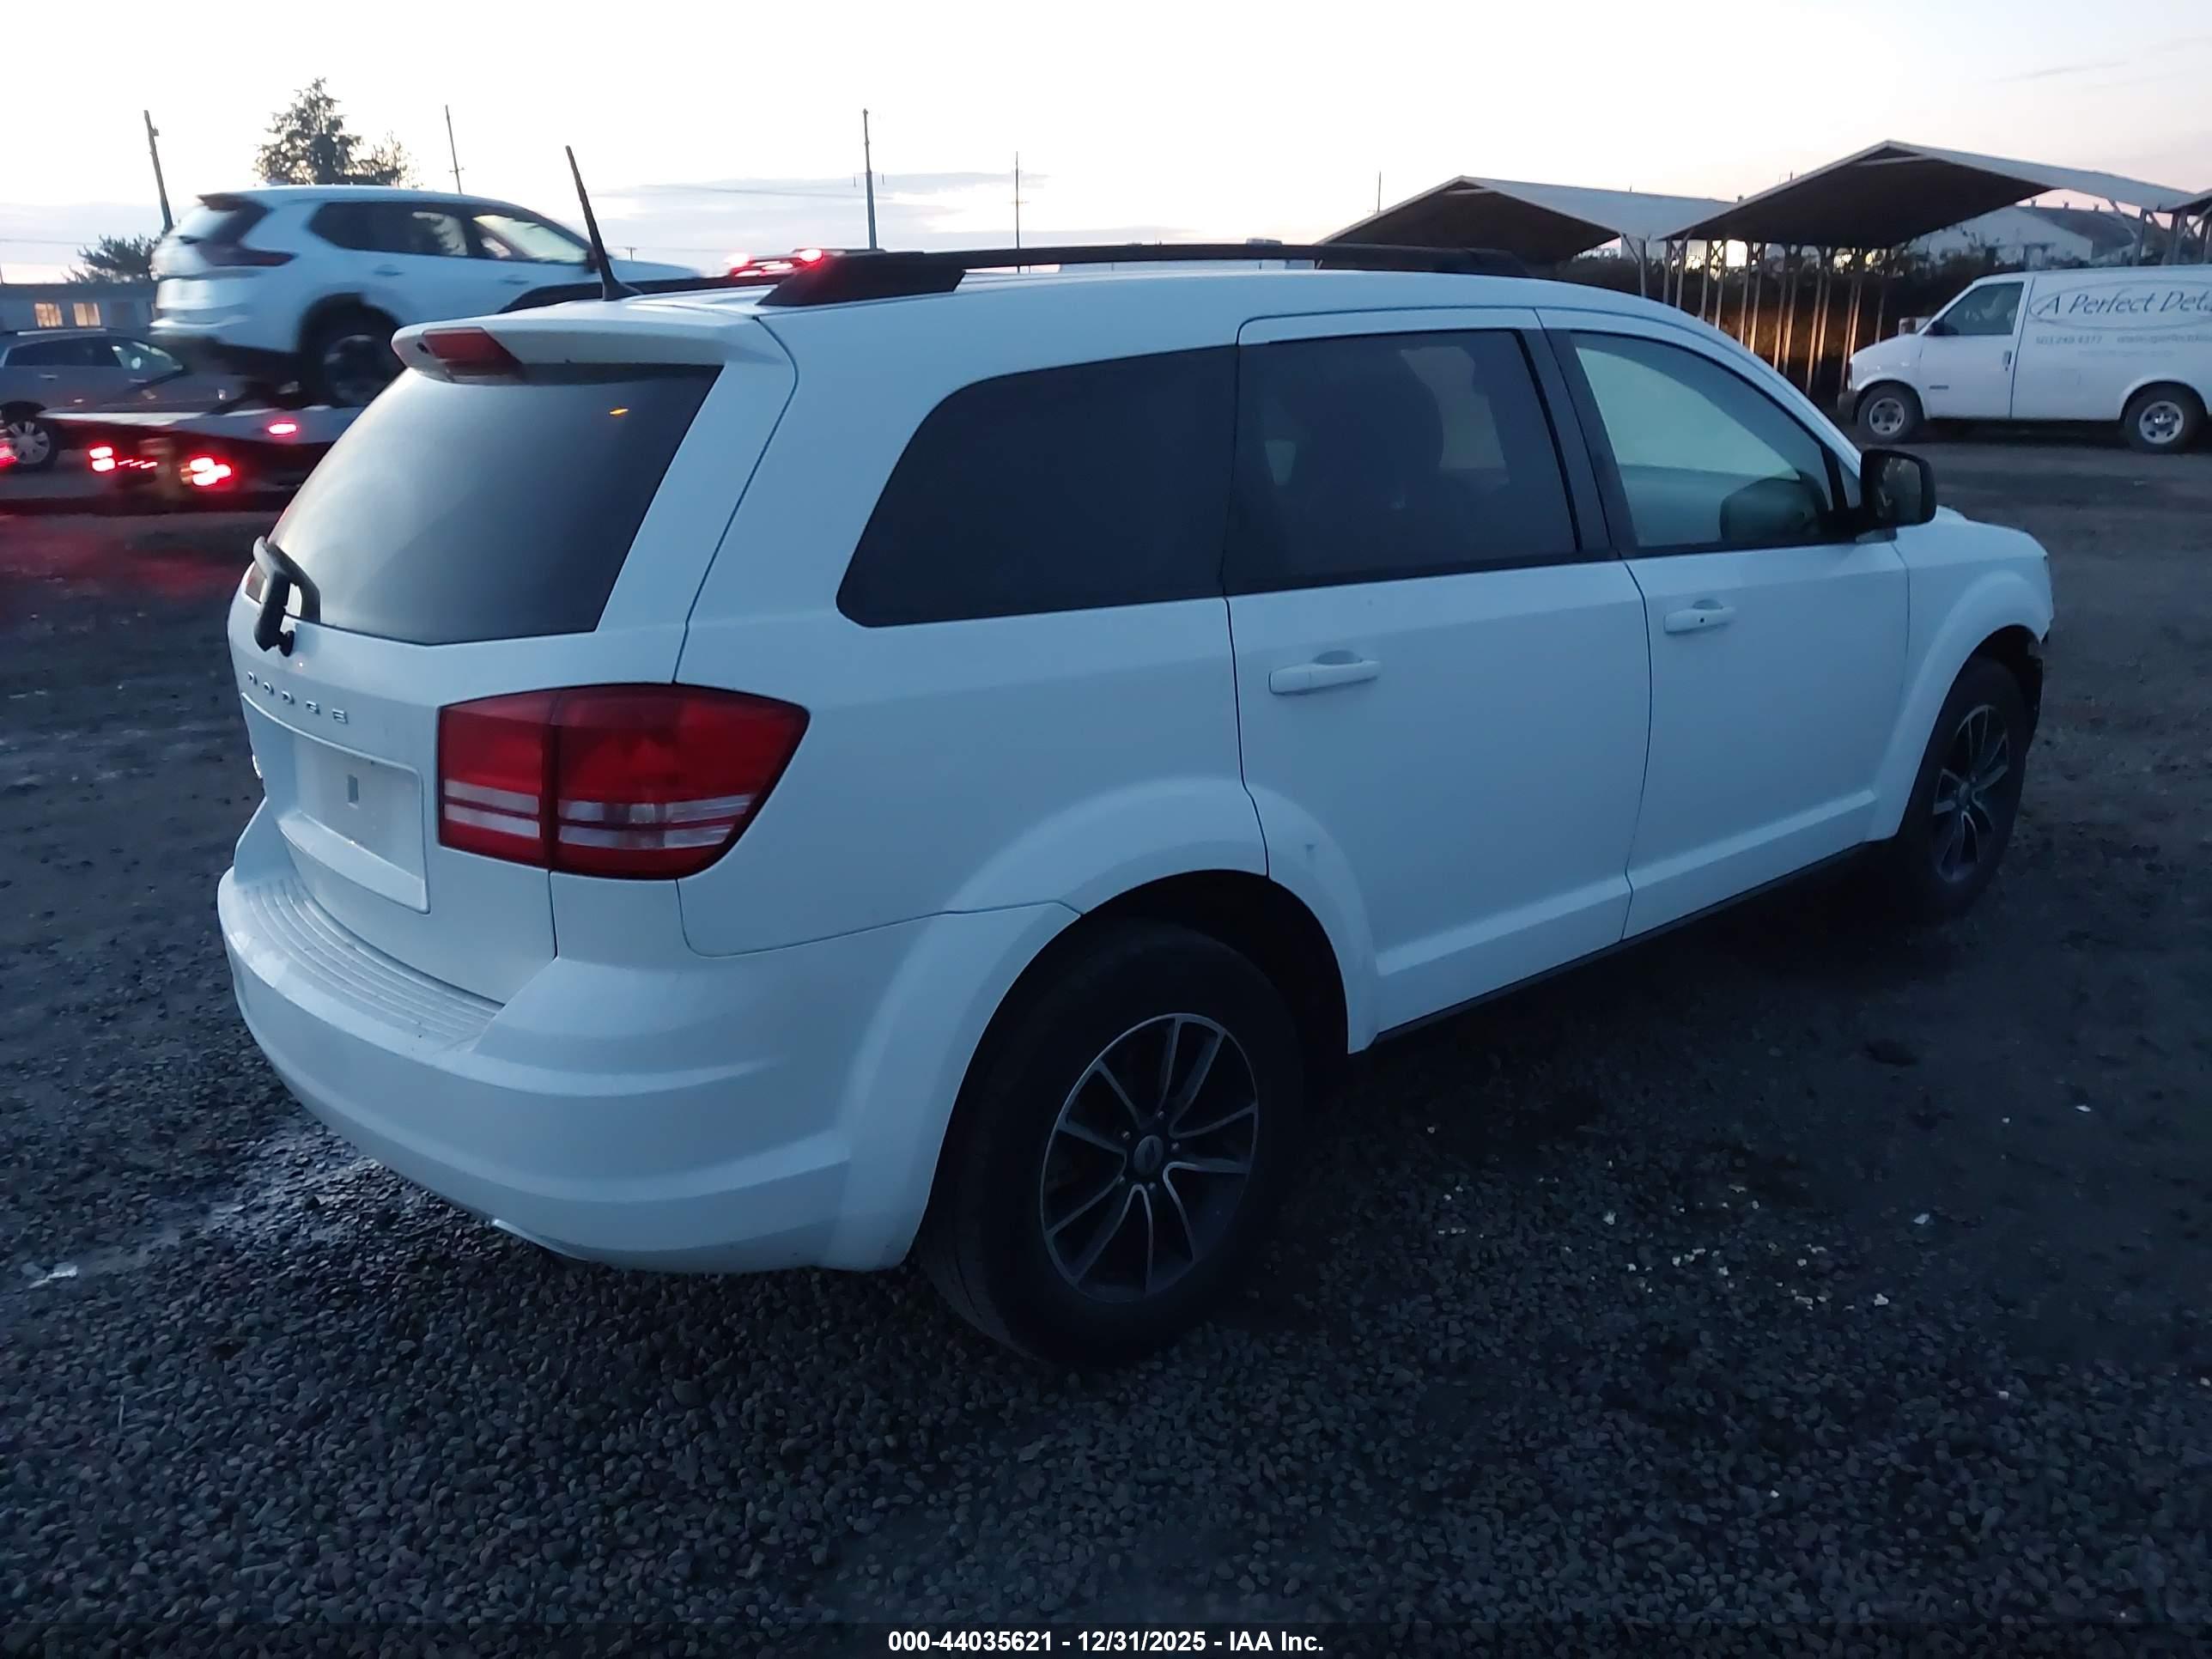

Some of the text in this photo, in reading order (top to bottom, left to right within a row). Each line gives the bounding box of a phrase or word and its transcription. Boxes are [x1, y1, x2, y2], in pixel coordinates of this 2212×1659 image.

[2038, 295, 2060, 315] A
[2069, 288, 2156, 314] Perfect
[247, 671, 349, 724] DODGE
